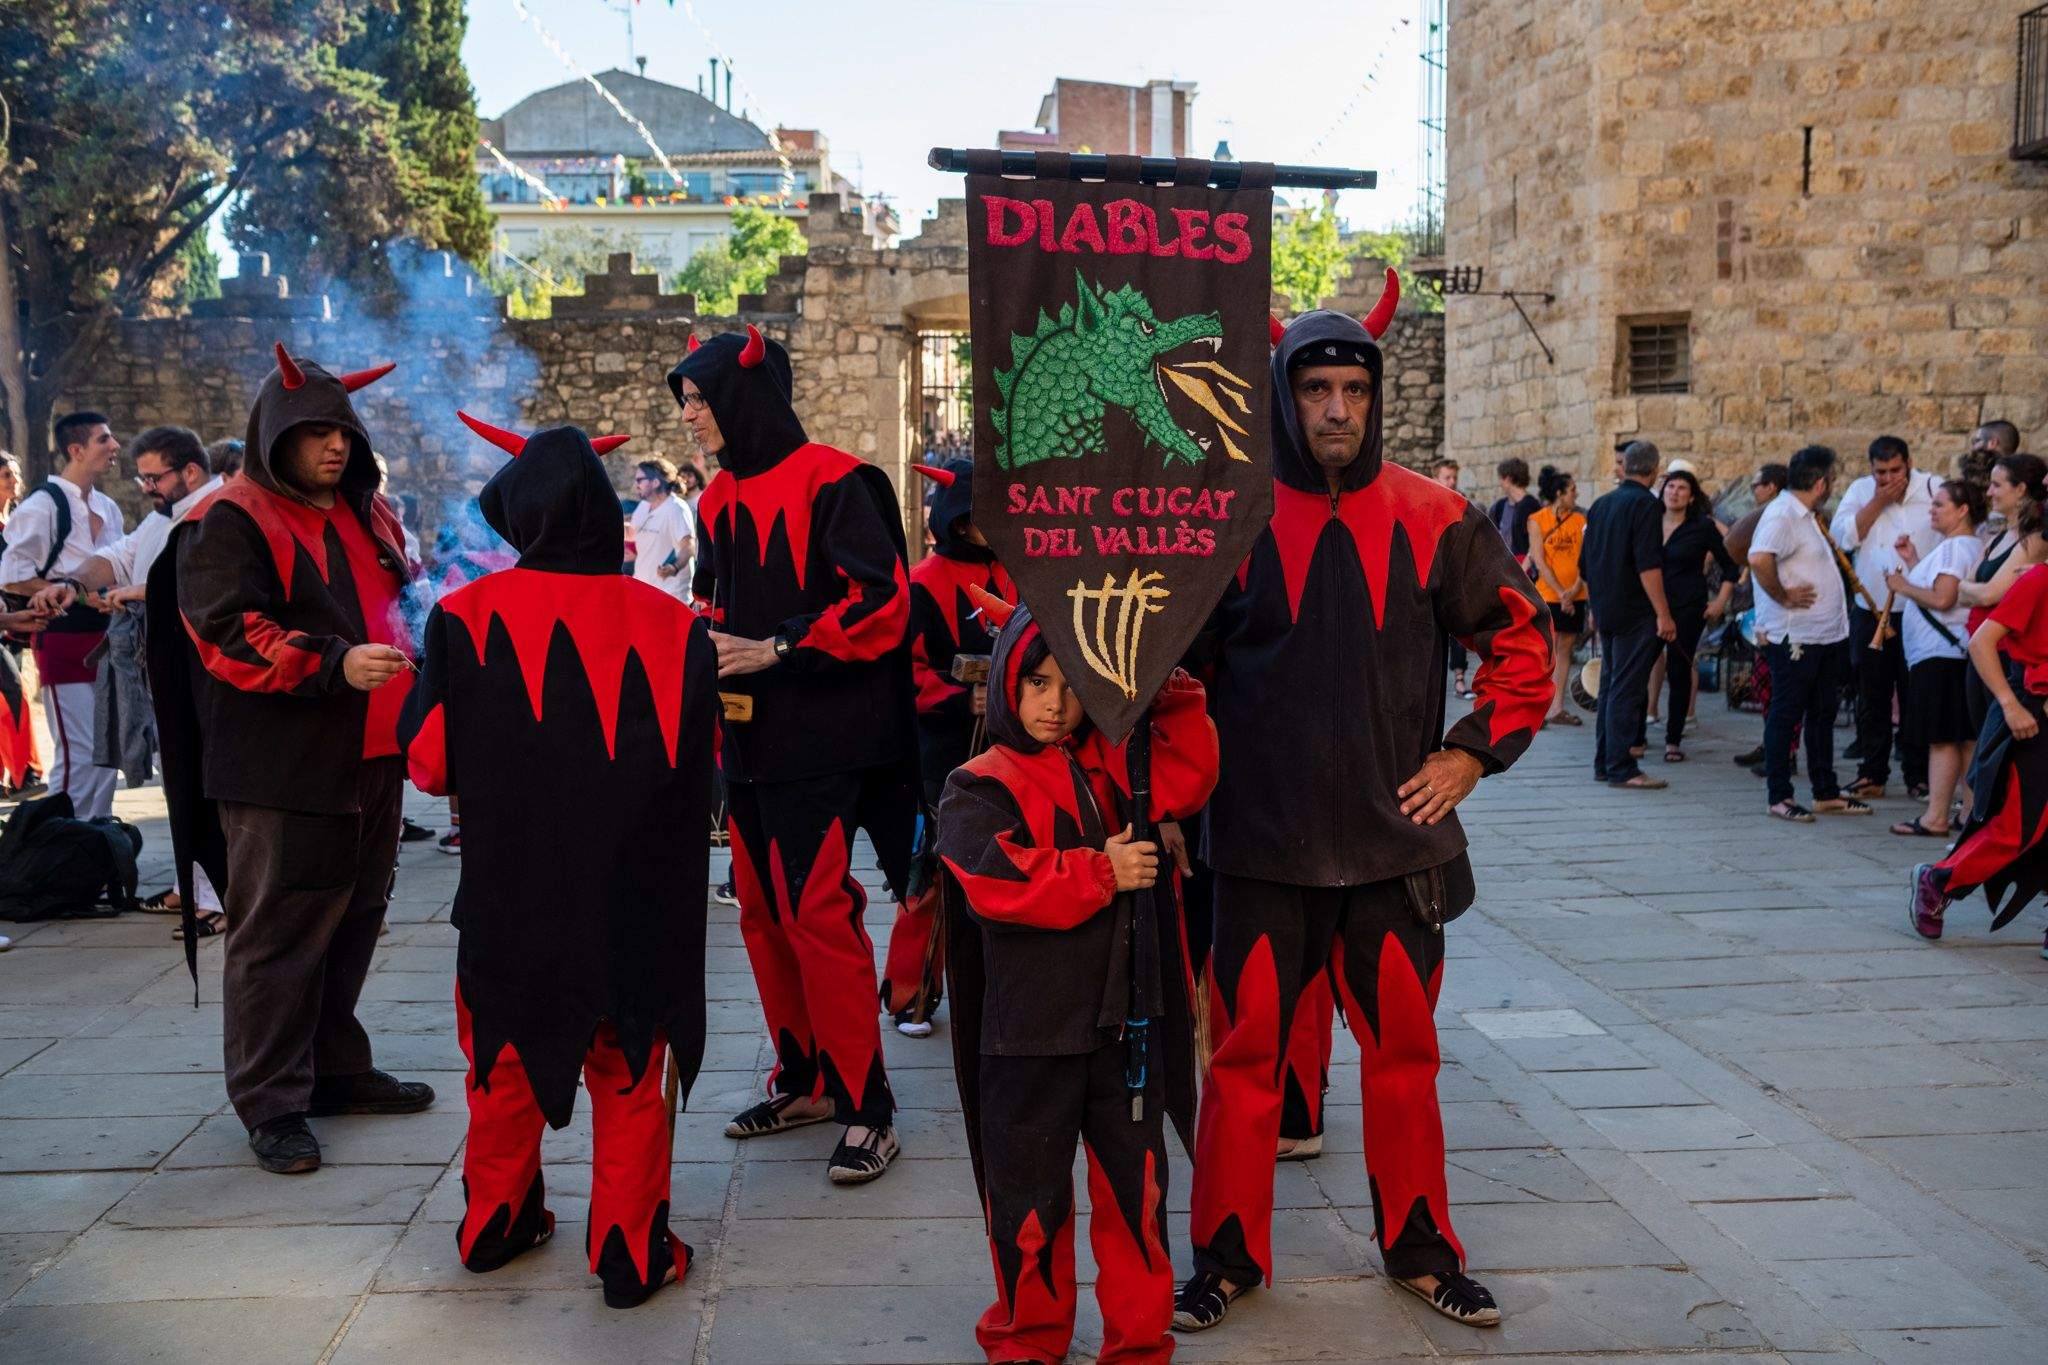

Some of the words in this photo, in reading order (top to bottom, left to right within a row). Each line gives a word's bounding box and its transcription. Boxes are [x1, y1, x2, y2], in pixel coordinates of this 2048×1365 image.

[980, 195, 1253, 264] DIABLES
[1007, 484, 1101, 516] SANT
[1112, 487, 1237, 520] CUGAT
[1024, 527, 1082, 557] DEL
[1091, 520, 1216, 557] VALLÈS
